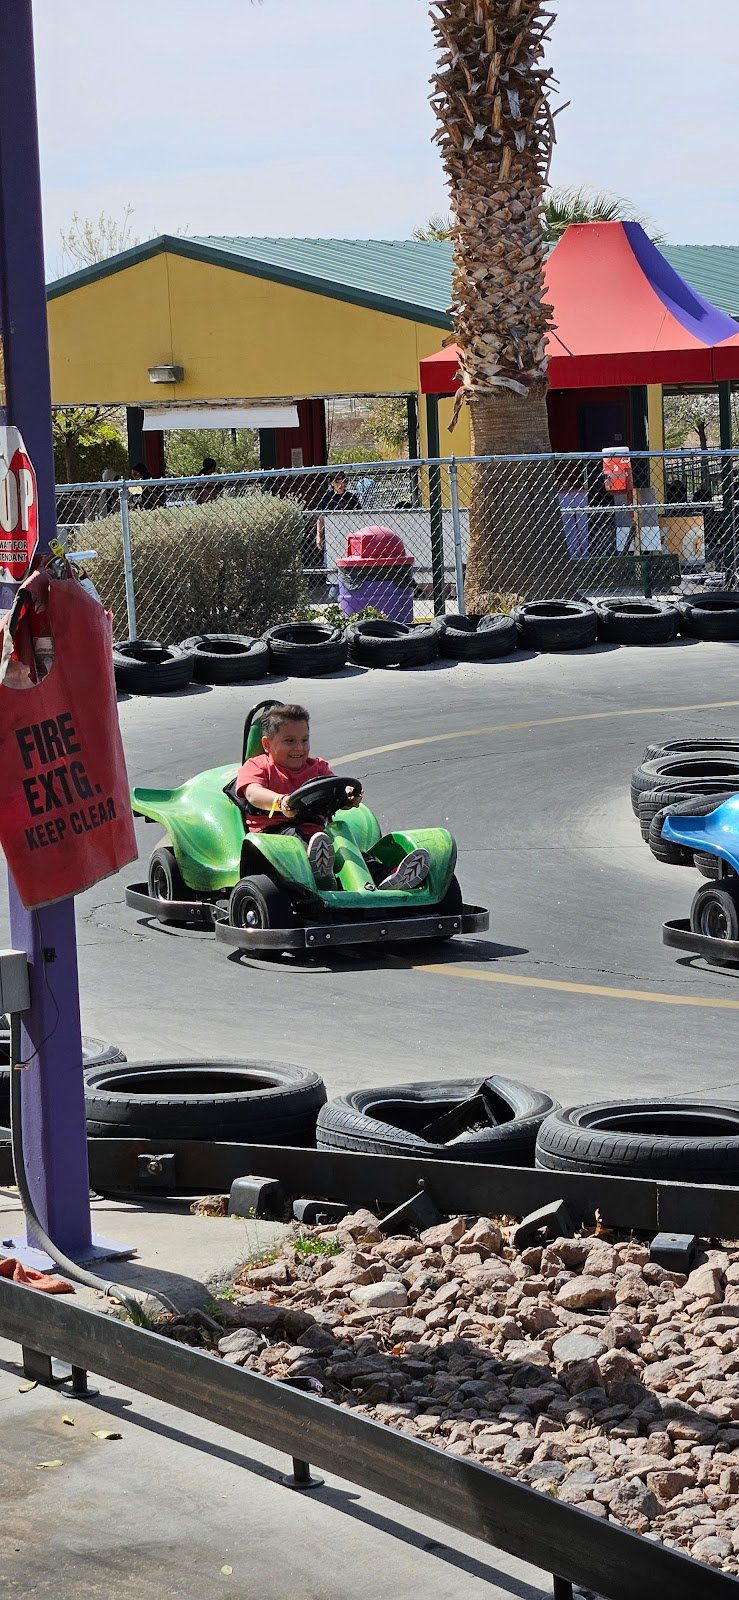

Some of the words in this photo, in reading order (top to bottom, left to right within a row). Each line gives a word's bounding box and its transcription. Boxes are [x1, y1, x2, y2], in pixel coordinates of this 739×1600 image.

[15, 711, 82, 770] FIRE
[22, 760, 102, 817] EXTG.
[24, 816, 67, 851] KEEP
[69, 796, 117, 836] CLEAR
